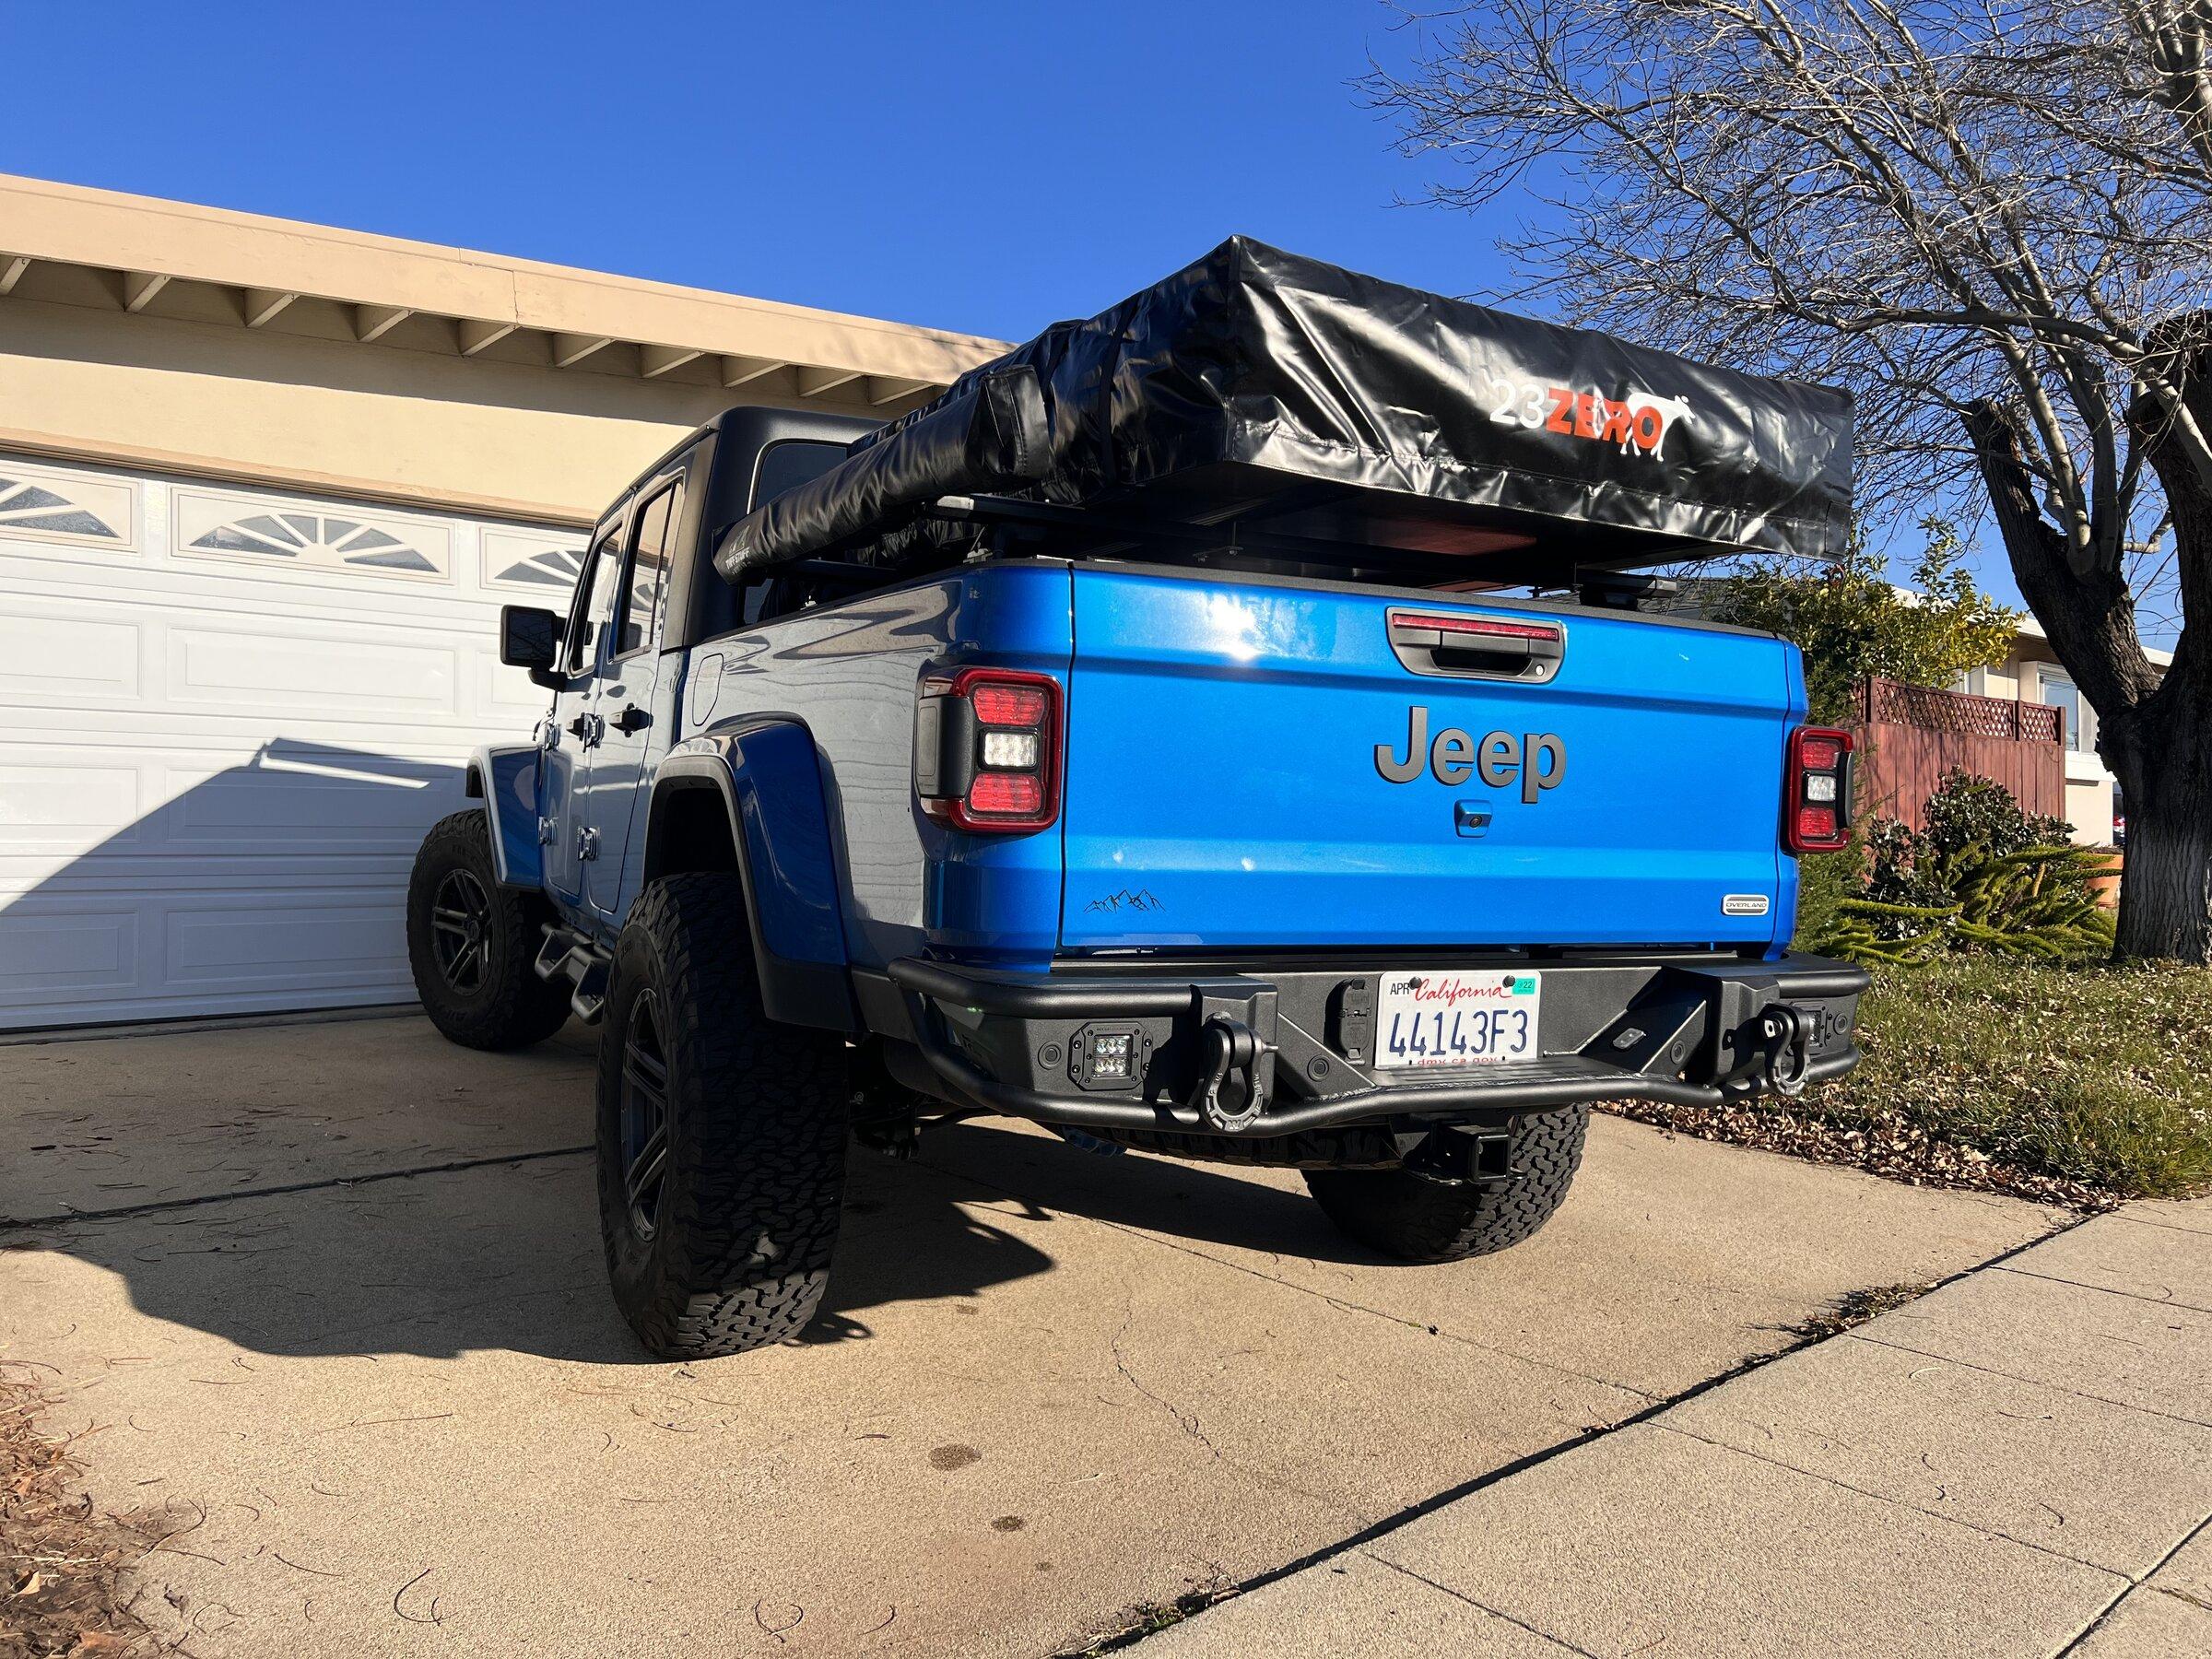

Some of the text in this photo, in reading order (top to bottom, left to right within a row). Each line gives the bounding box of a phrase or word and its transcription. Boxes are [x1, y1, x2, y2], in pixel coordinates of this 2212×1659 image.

[1489, 378, 1664, 450] 23ZERO
[1374, 706, 1566, 804] Jeep
[1390, 982, 1410, 995] APR
[1415, 978, 1512, 1007] California
[1389, 1009, 1528, 1057] 44143F3
